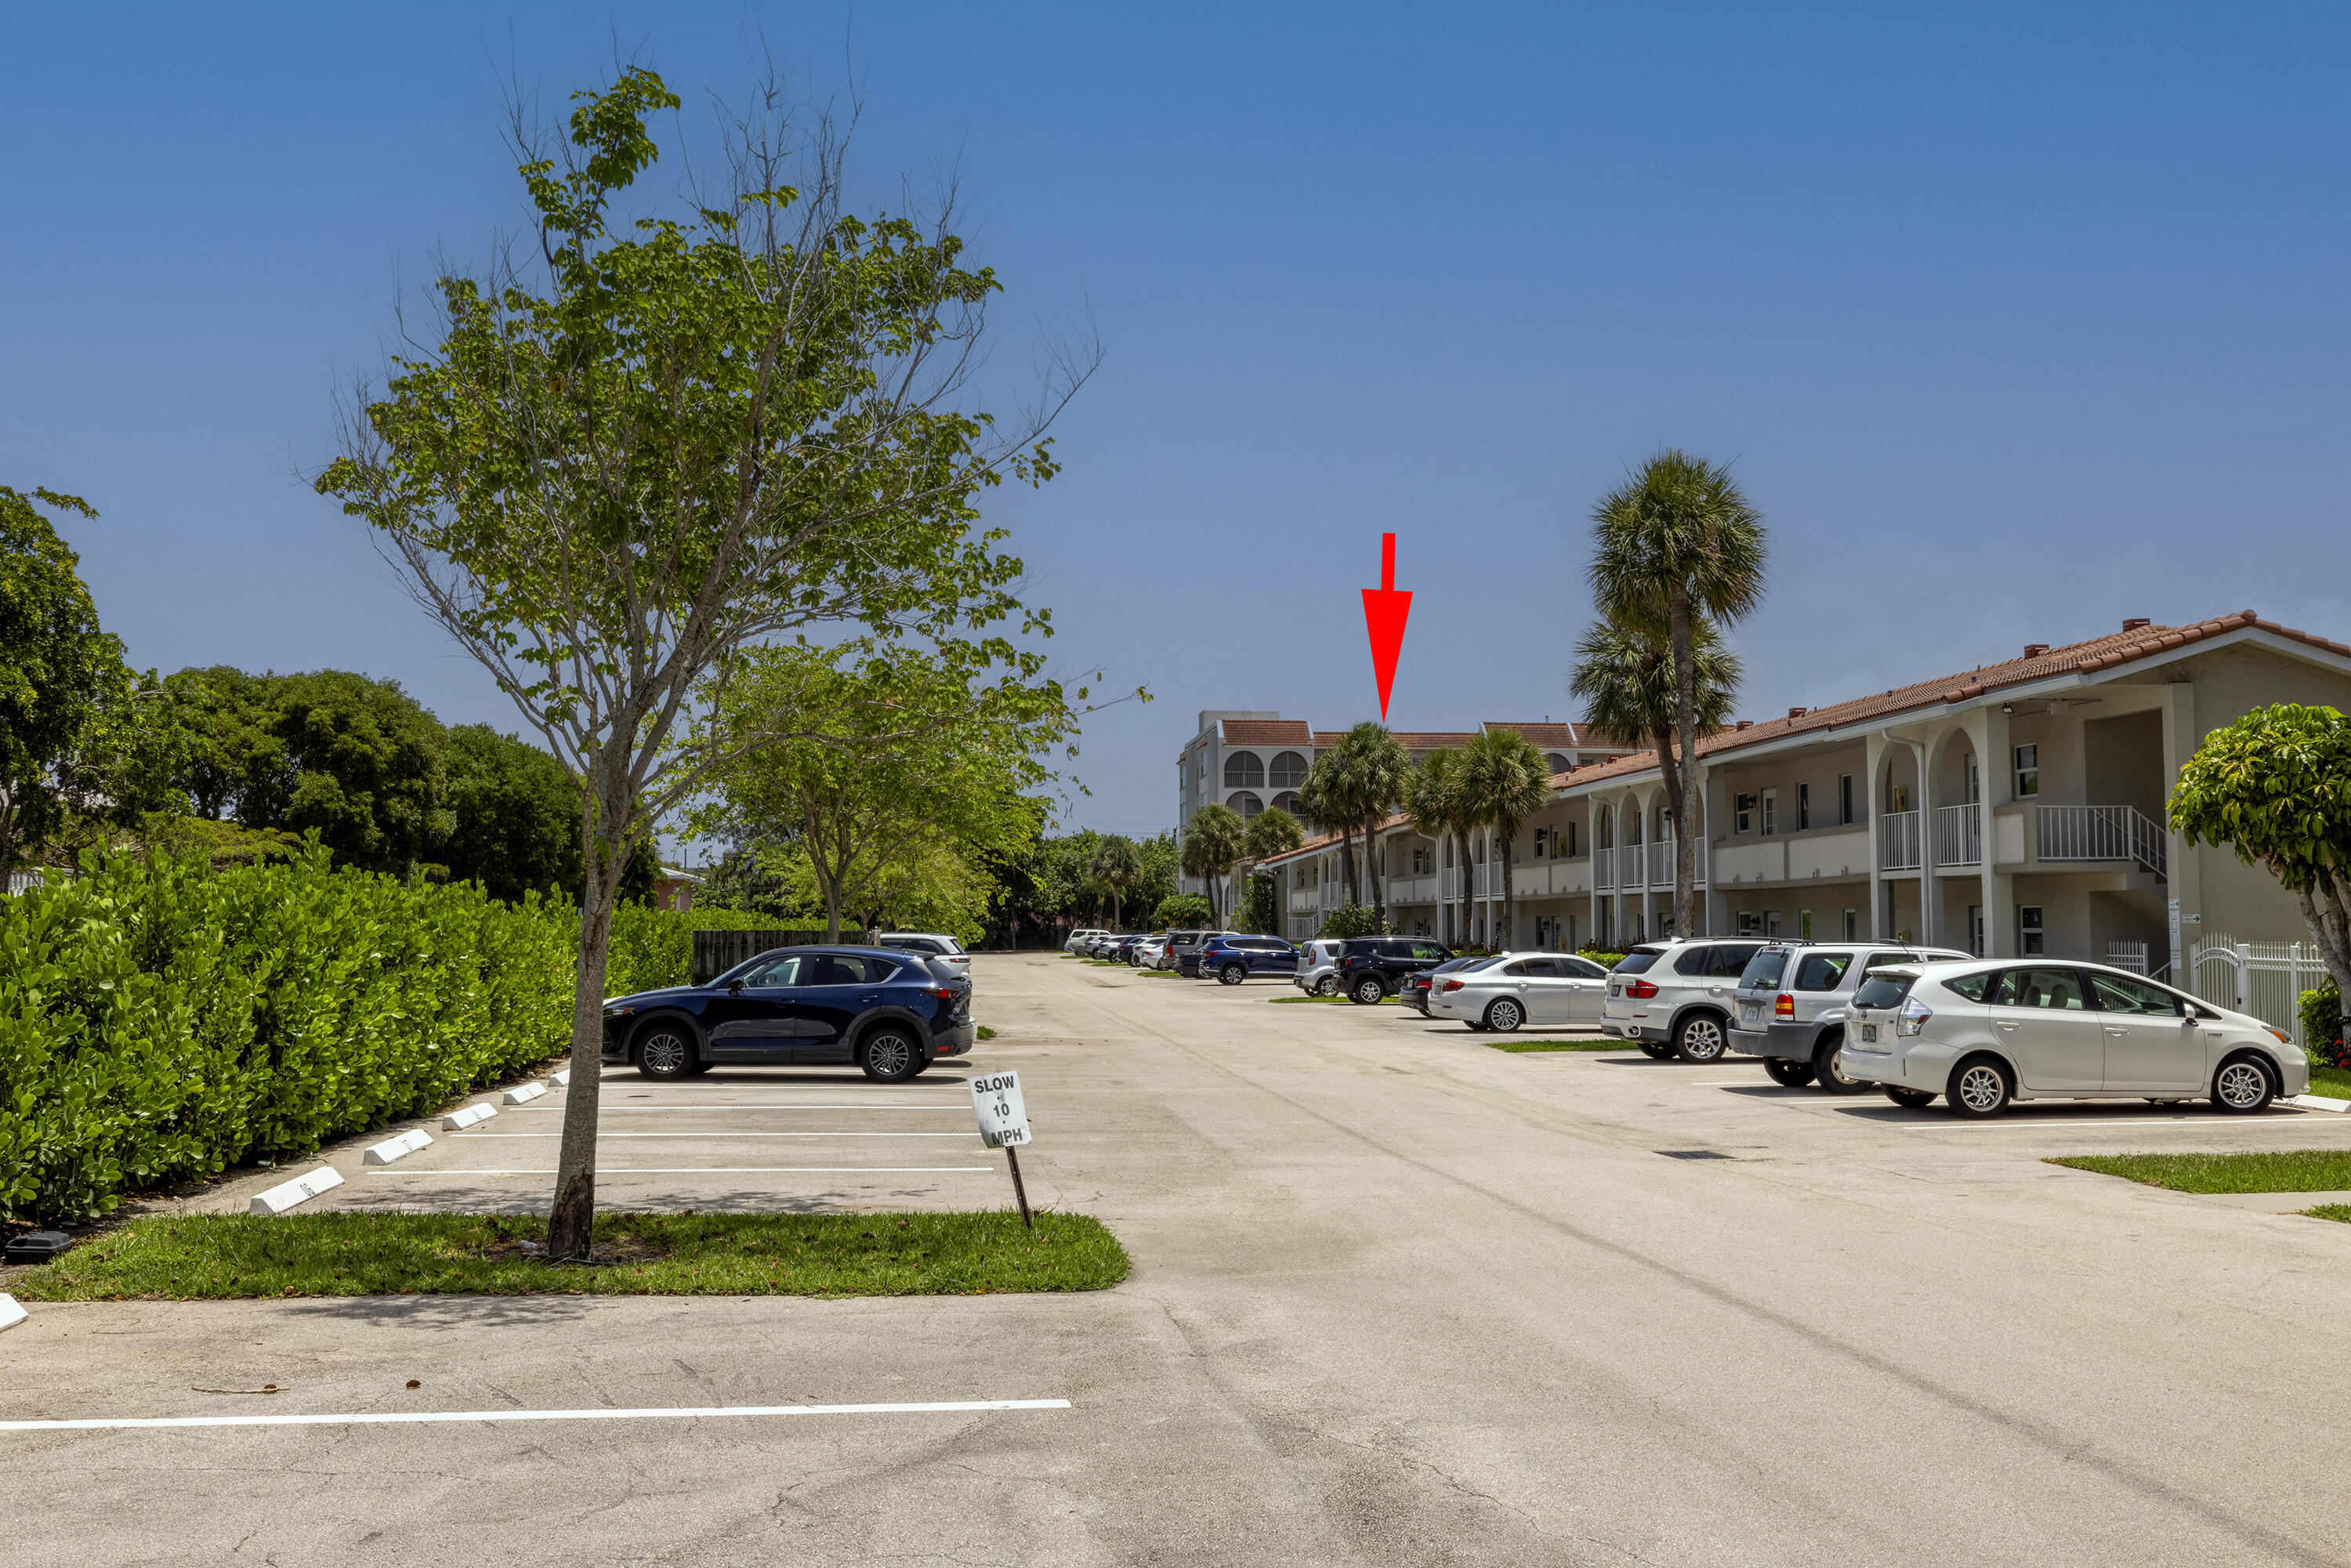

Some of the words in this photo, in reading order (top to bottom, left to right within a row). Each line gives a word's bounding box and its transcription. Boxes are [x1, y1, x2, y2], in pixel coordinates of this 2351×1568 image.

[974, 1075, 1014, 1093] SLOW
[993, 1103, 1010, 1117] 10
[991, 1128, 1023, 1146] MPH
